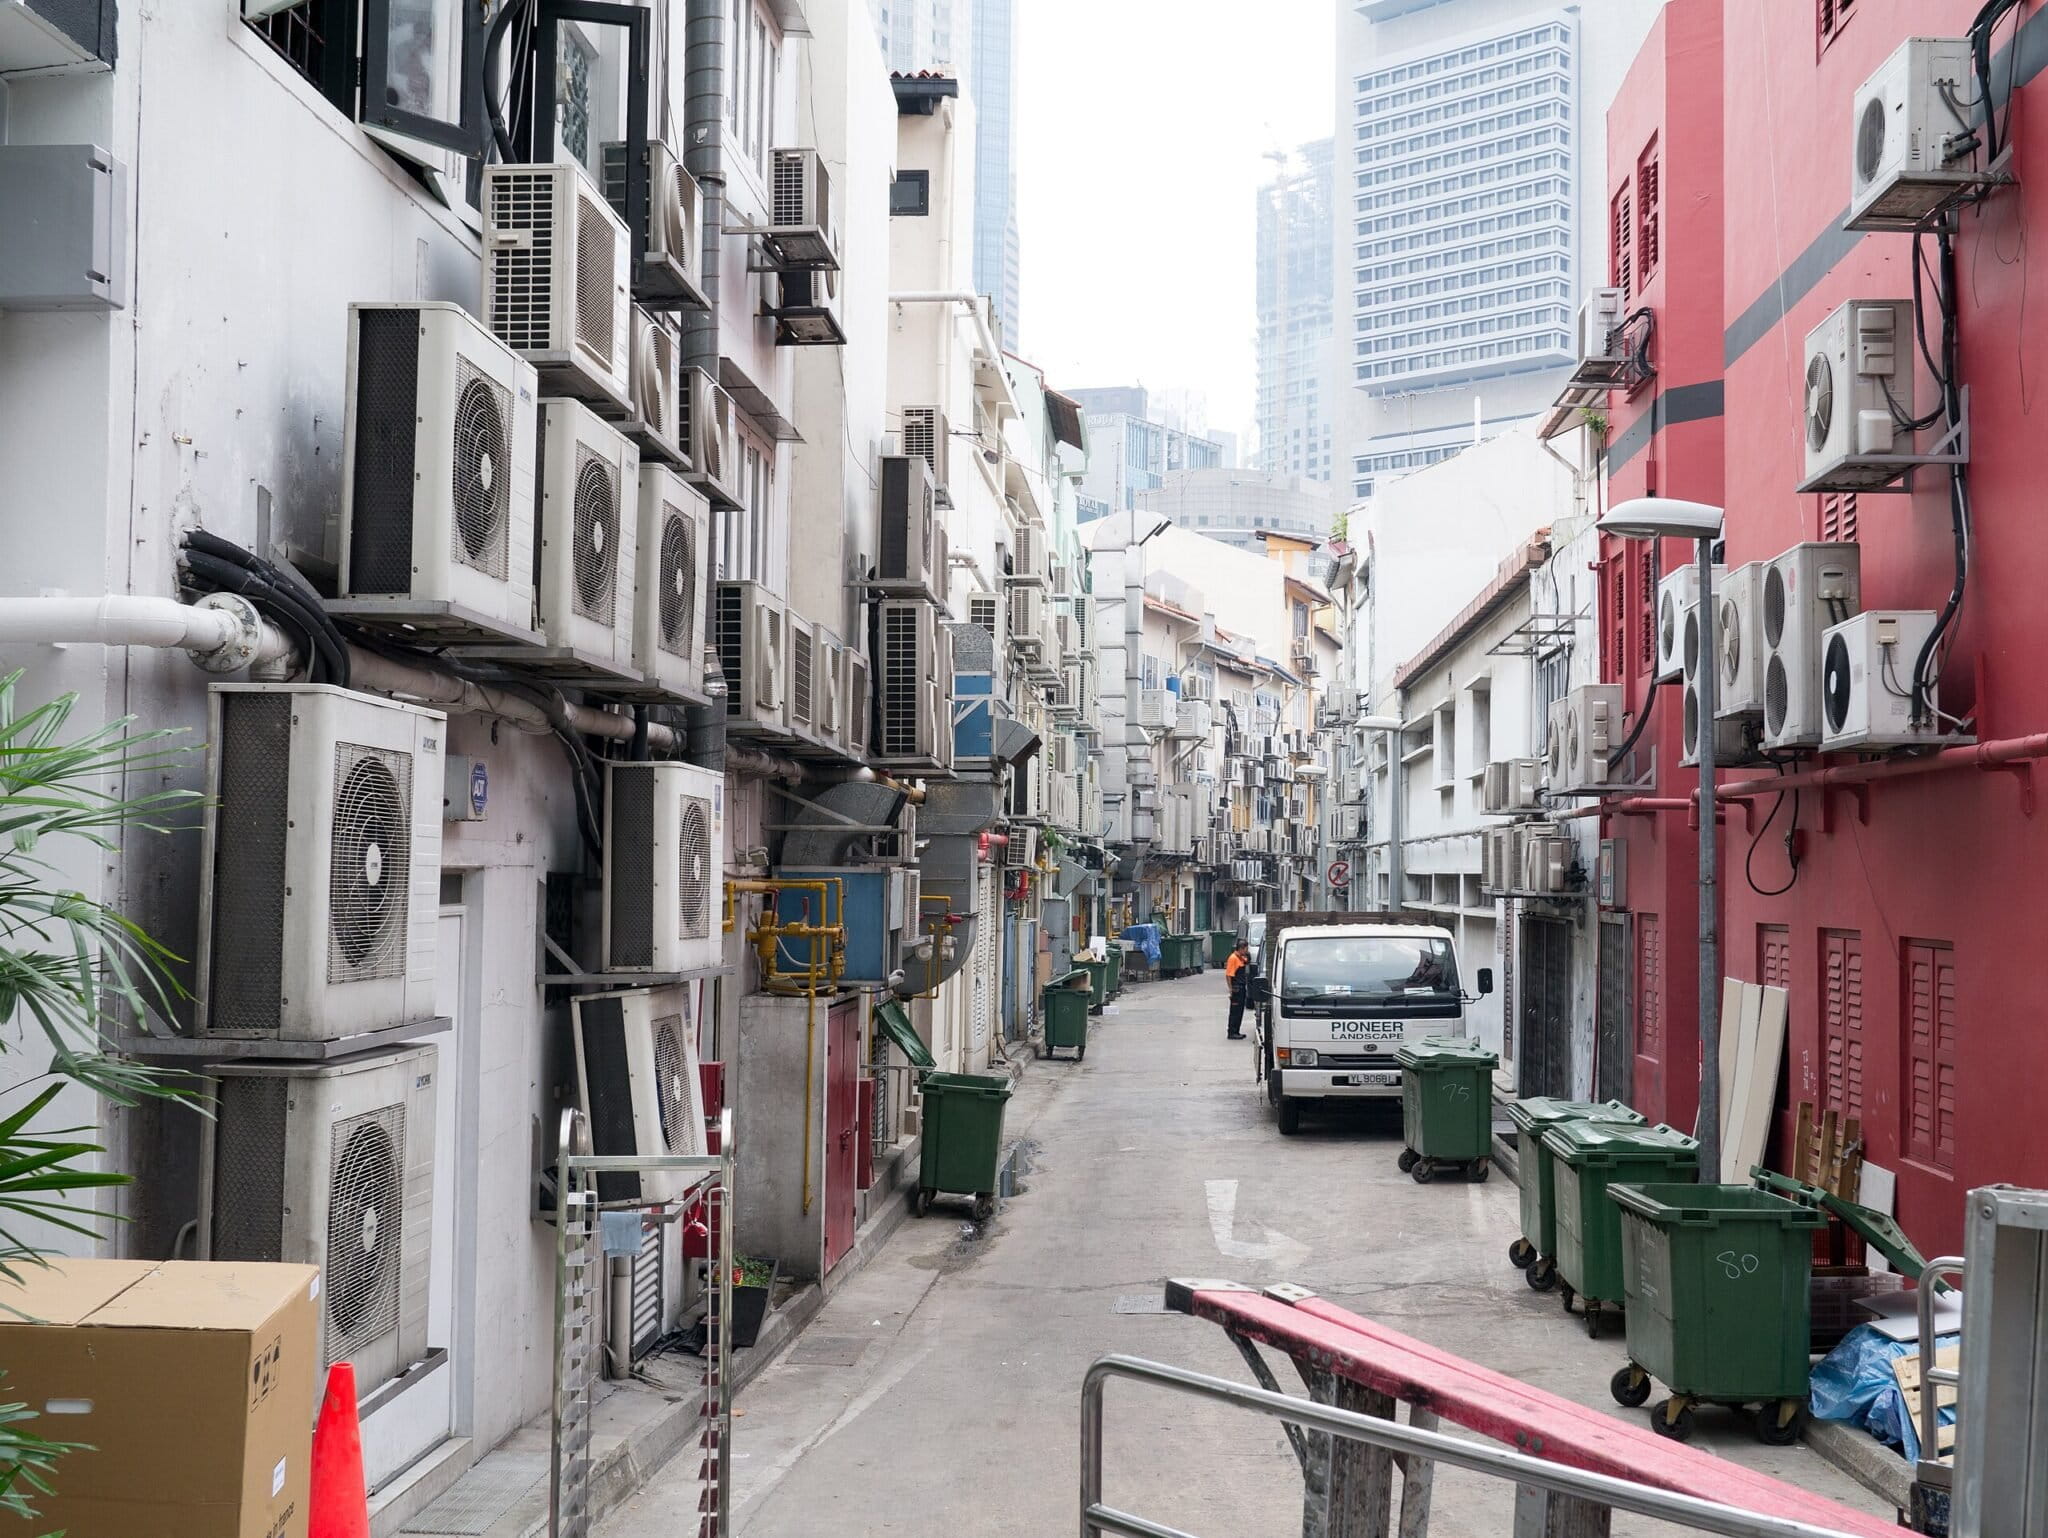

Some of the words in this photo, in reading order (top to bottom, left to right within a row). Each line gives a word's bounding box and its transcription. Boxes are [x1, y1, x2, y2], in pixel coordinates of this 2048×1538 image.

[1331, 1022, 1404, 1032] PIONEER
[1442, 1083, 1470, 1104] 75
[1715, 1250, 1760, 1279] 80
